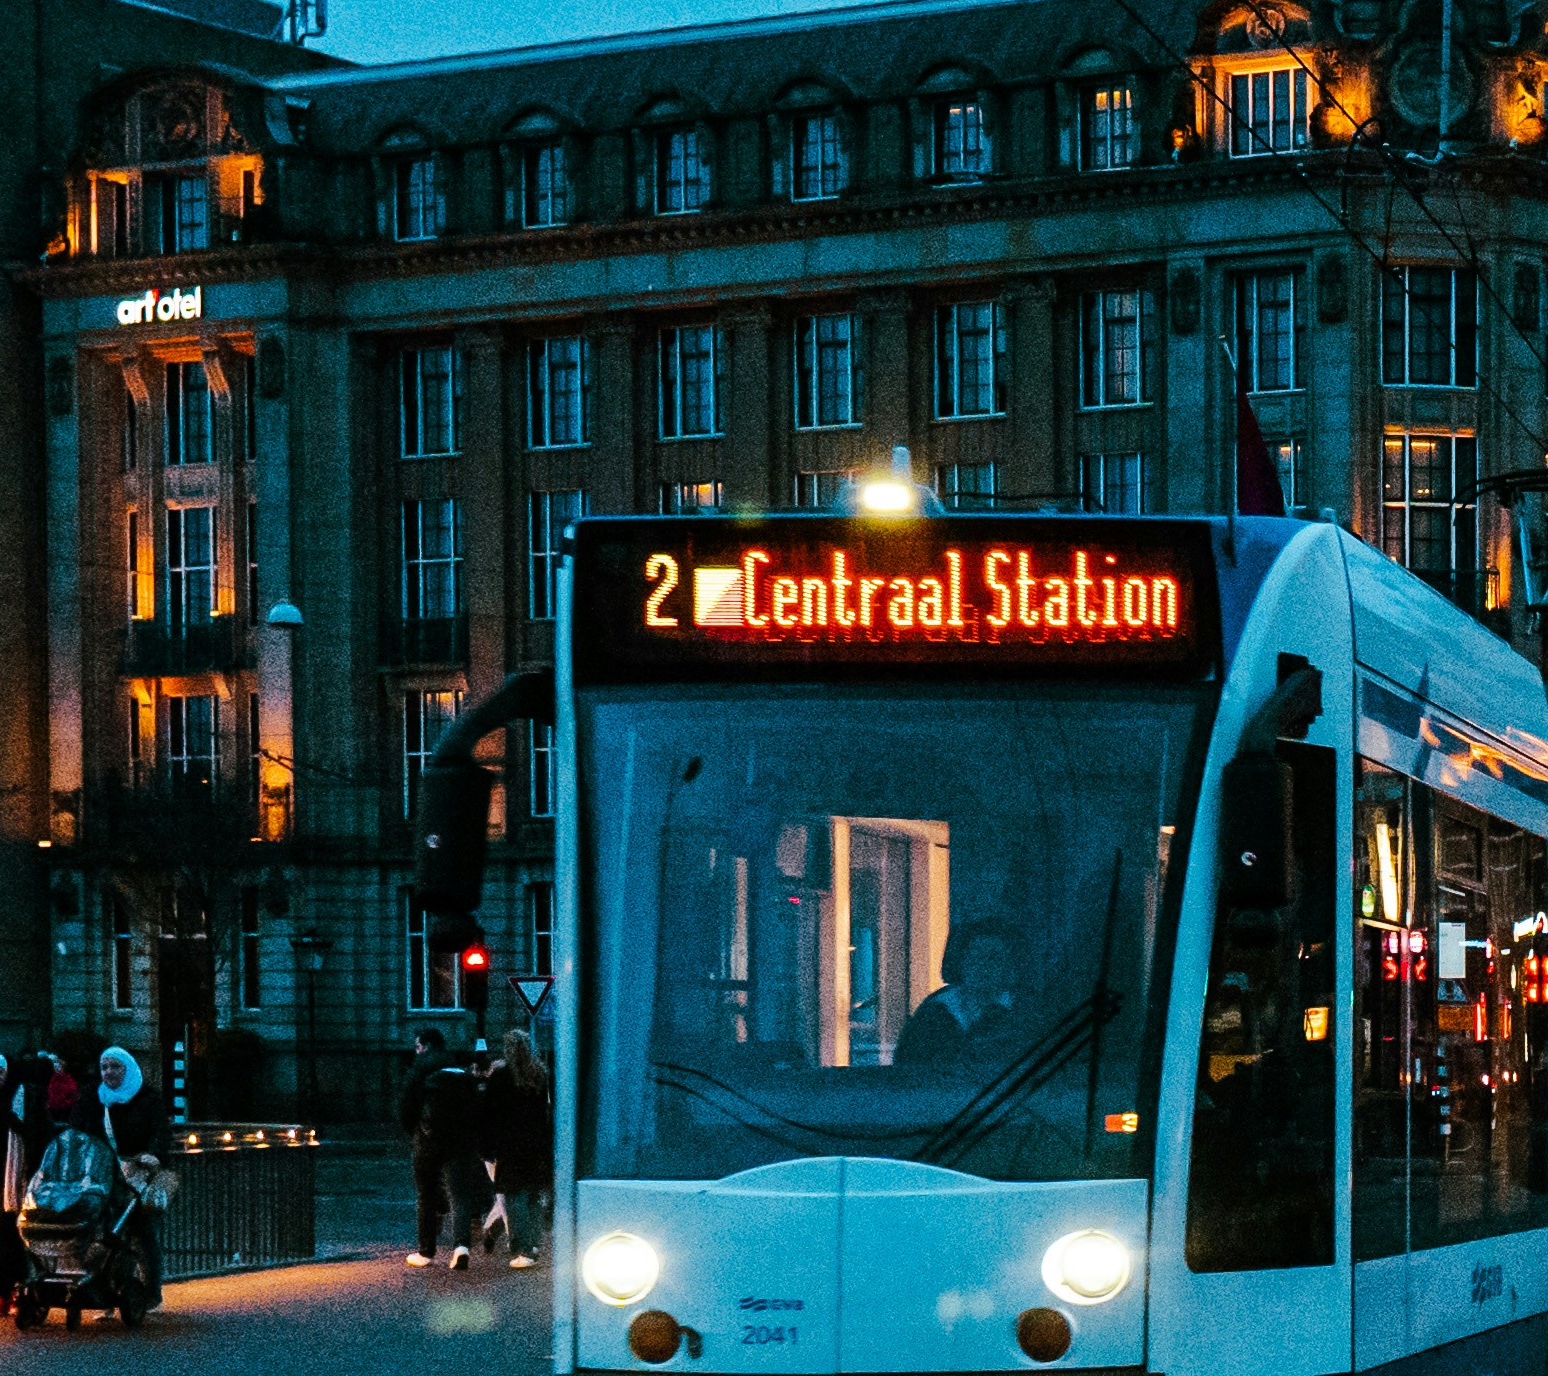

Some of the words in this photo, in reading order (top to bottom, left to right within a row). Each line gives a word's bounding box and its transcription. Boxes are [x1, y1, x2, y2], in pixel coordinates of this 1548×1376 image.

[646, 553, 679, 627] 2
[744, 549, 964, 627] Centraal
[986, 550, 1177, 627] Station
[741, 1325, 798, 1345] 2041
